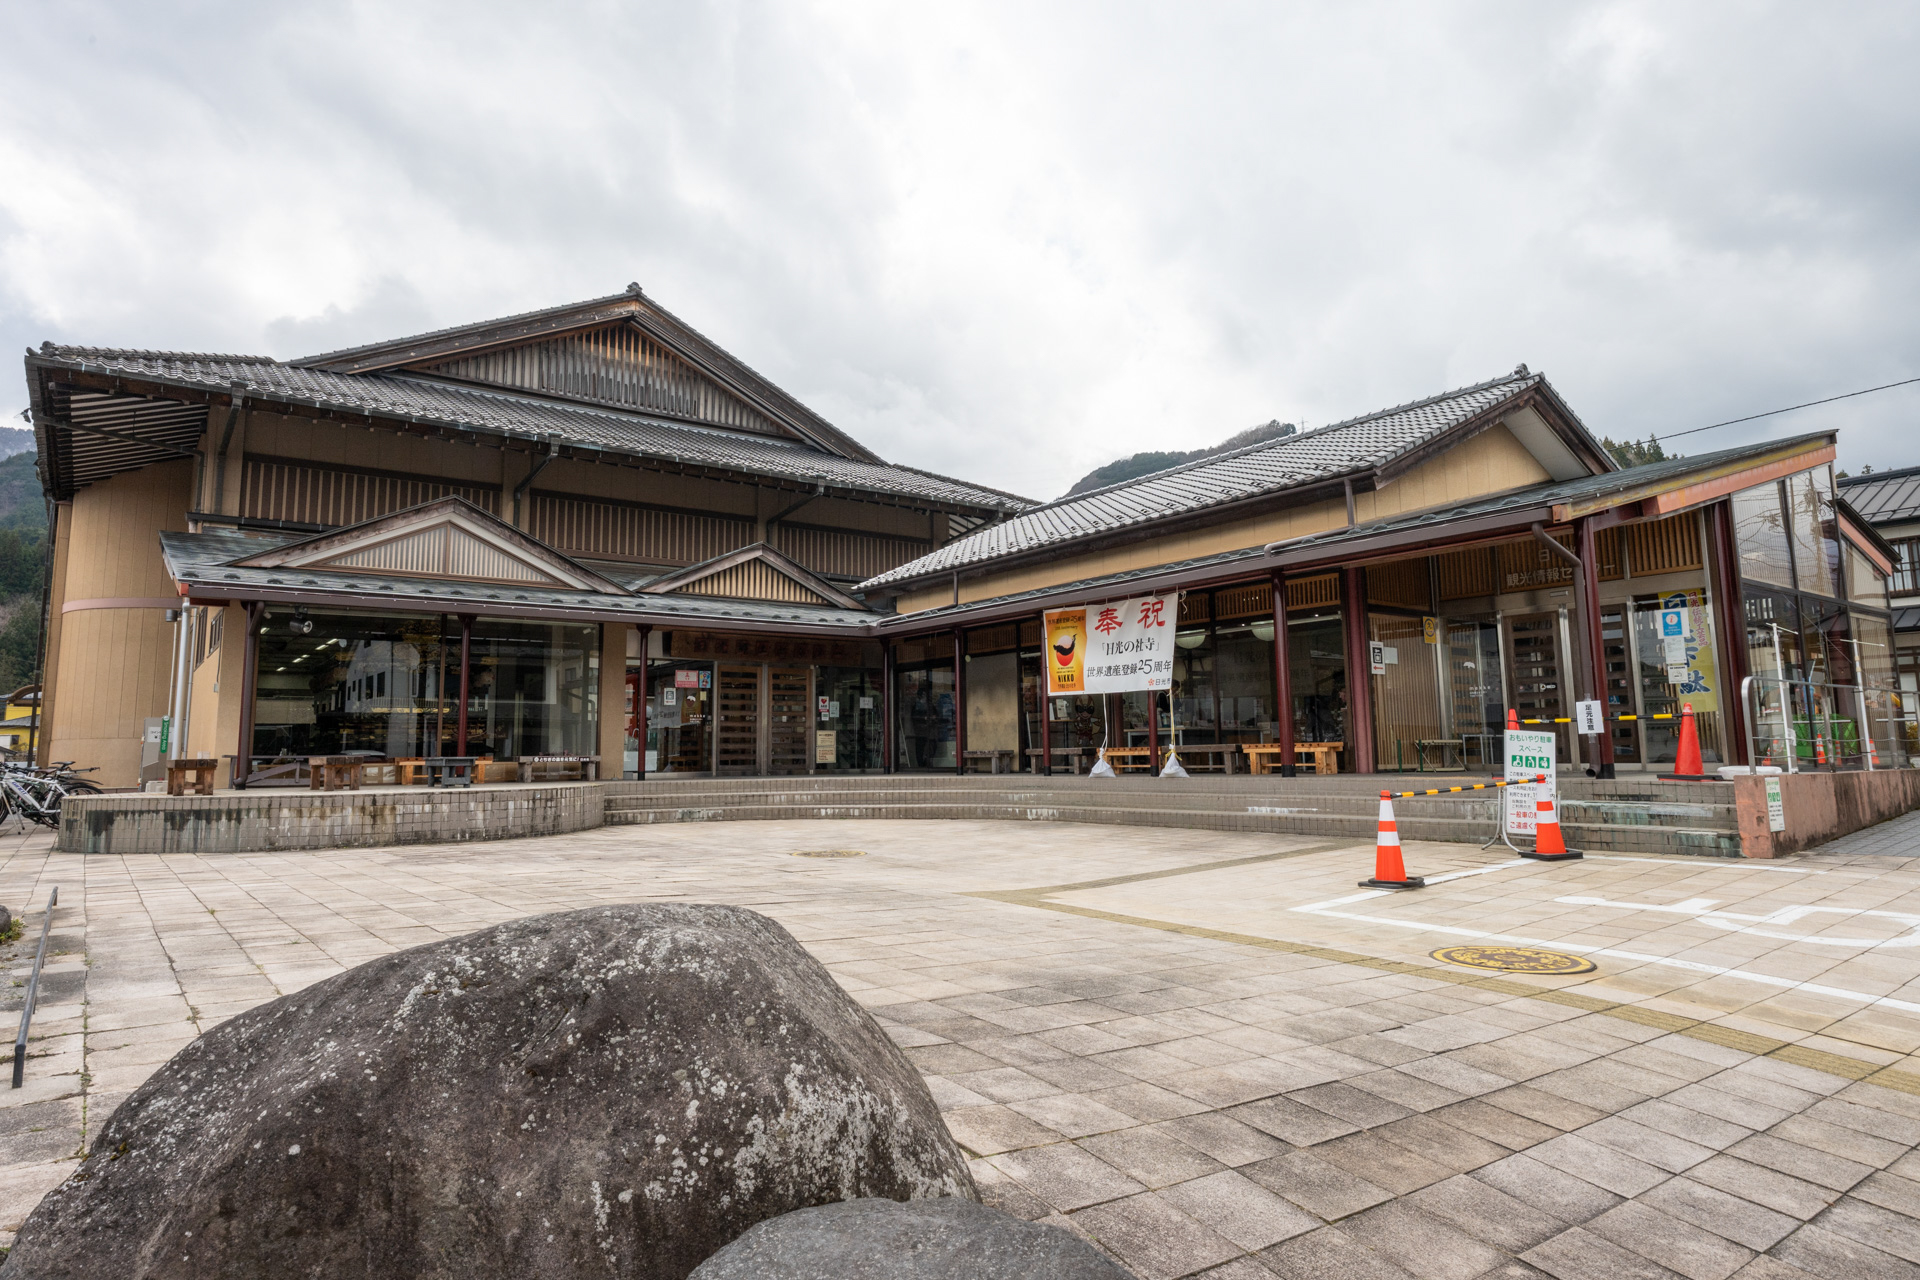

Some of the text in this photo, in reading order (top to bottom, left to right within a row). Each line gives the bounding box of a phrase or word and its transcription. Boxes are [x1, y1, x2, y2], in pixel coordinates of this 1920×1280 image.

[1507, 563, 1616, 586] 観光情報セー
[1102, 637, 1160, 656] 「日光の社寺」
[1087, 659, 1172, 677] 世界遺産登録25周年
[1058, 674, 1075, 683] NIKKO
[1585, 704, 1594, 730] 足元注意
[1509, 734, 1552, 743] おもいやり駐車
[1518, 745, 1543, 753] スペース
